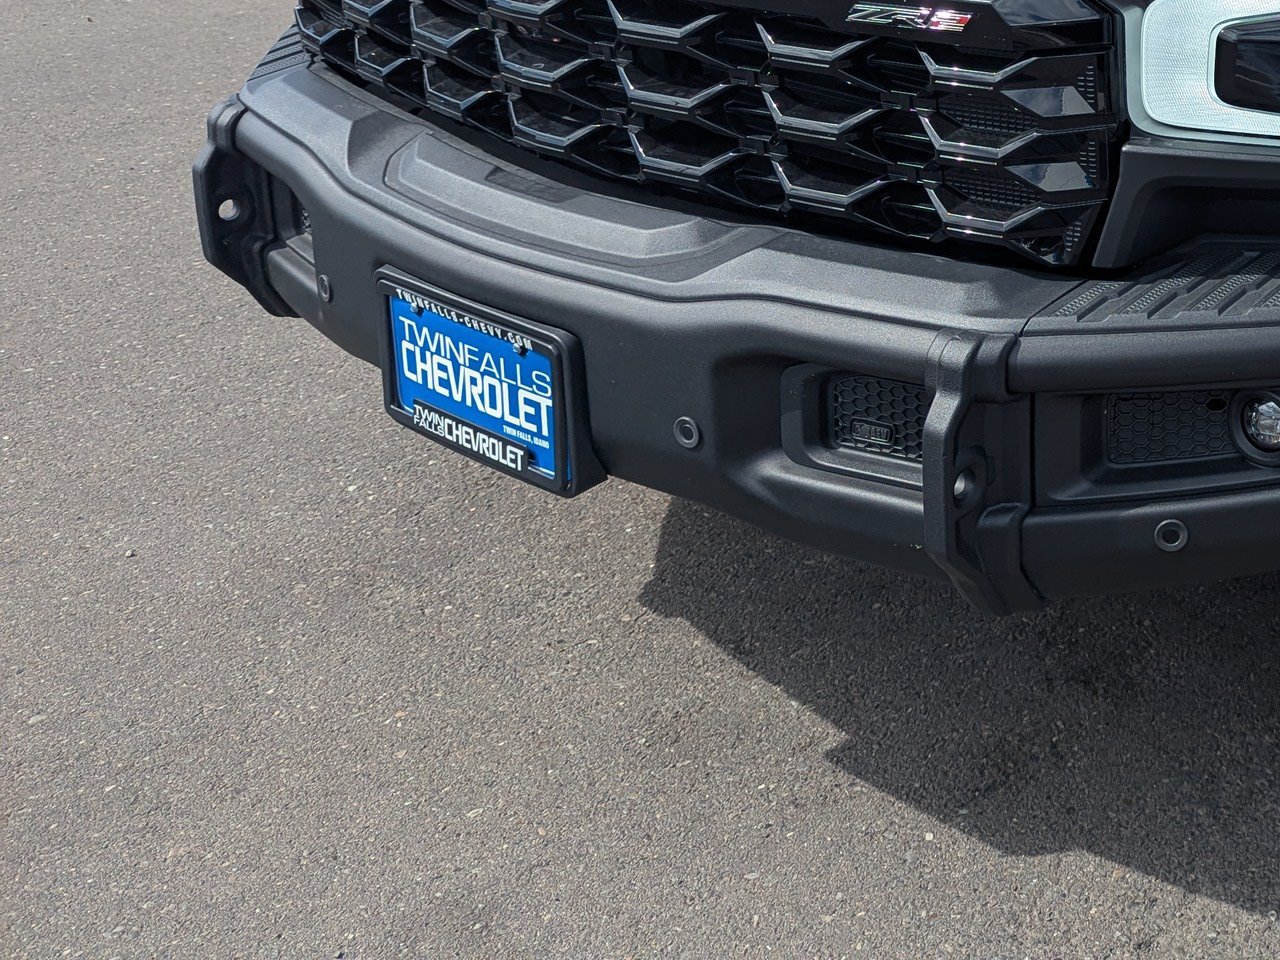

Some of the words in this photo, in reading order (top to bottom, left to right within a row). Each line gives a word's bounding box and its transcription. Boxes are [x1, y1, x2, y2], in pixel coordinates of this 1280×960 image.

[402, 340, 553, 437] CHEVROLET
[413, 404, 445, 425] TWIN
[413, 417, 446, 437] FALLS
[503, 425, 517, 436] TWIN
[533, 436, 549, 449] IDAHO
[445, 419, 524, 471] CHEVROLET
